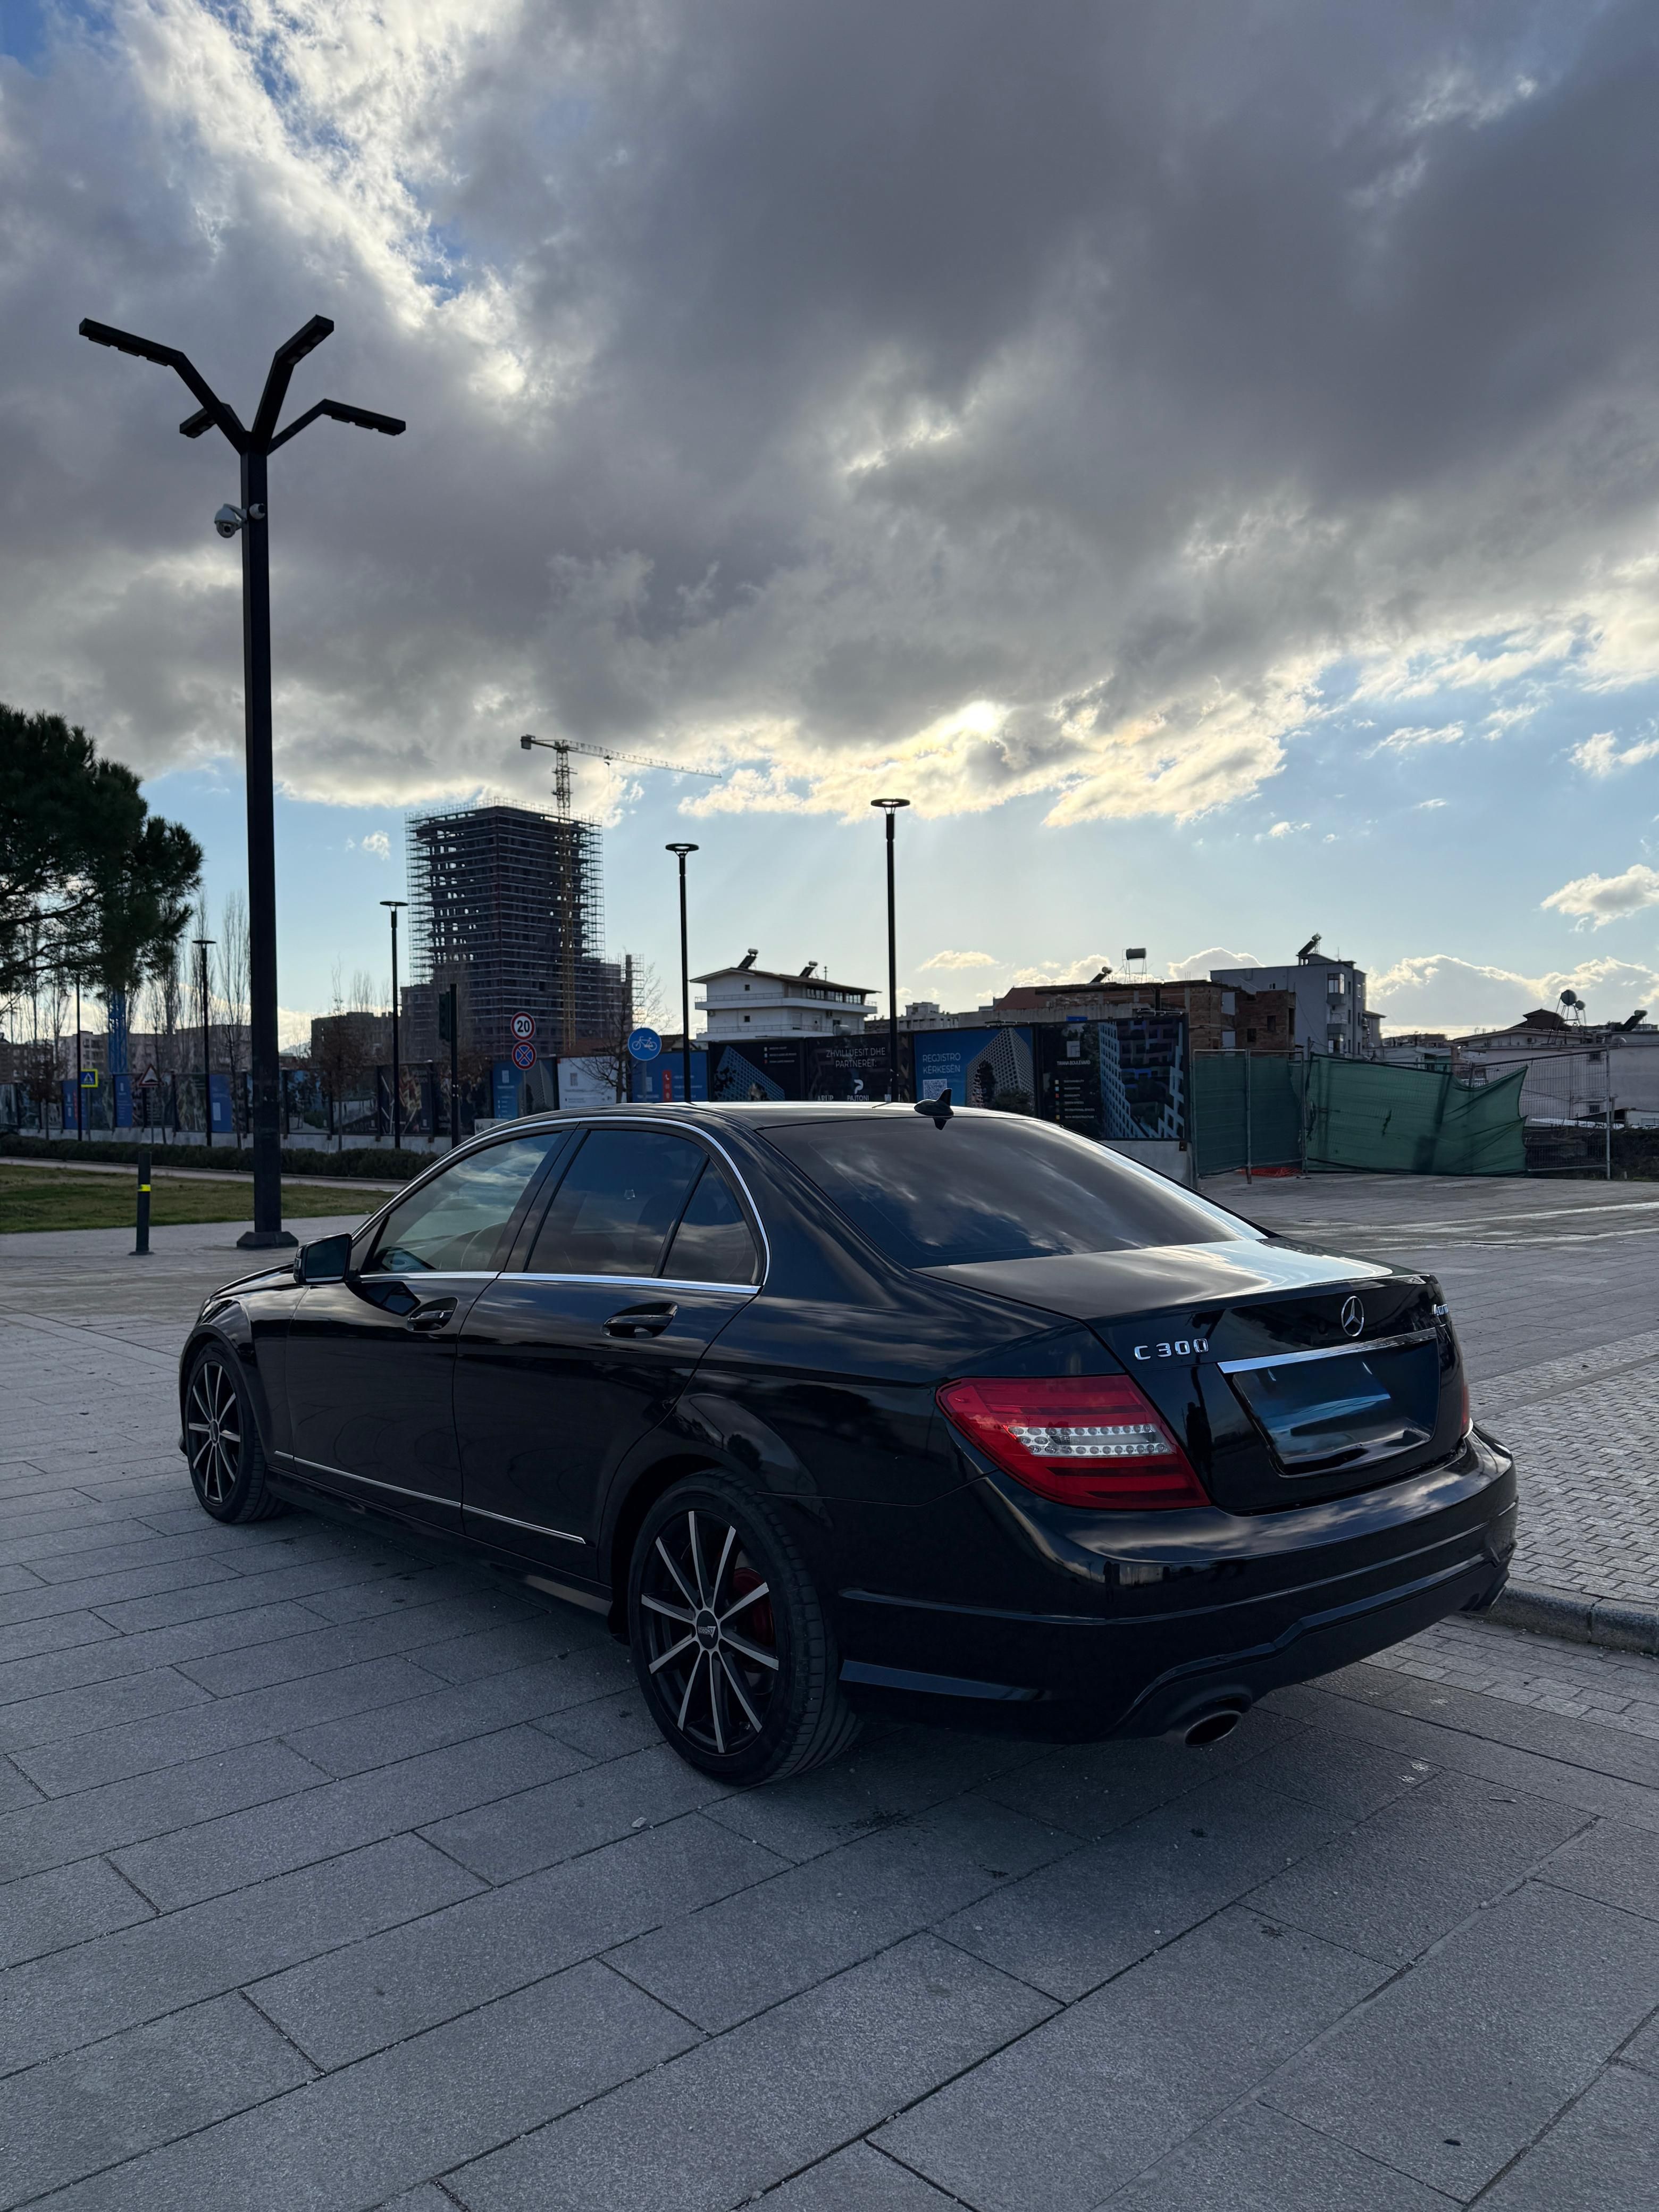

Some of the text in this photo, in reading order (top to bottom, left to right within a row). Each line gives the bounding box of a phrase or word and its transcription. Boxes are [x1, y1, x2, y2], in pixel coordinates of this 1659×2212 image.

[517, 1020, 530, 1033] 20
[826, 1047, 886, 1058] ZHVILLUESIT DHE
[923, 1052, 961, 1063] REGJISTRO
[1134, 1338, 1209, 1360] C 300
